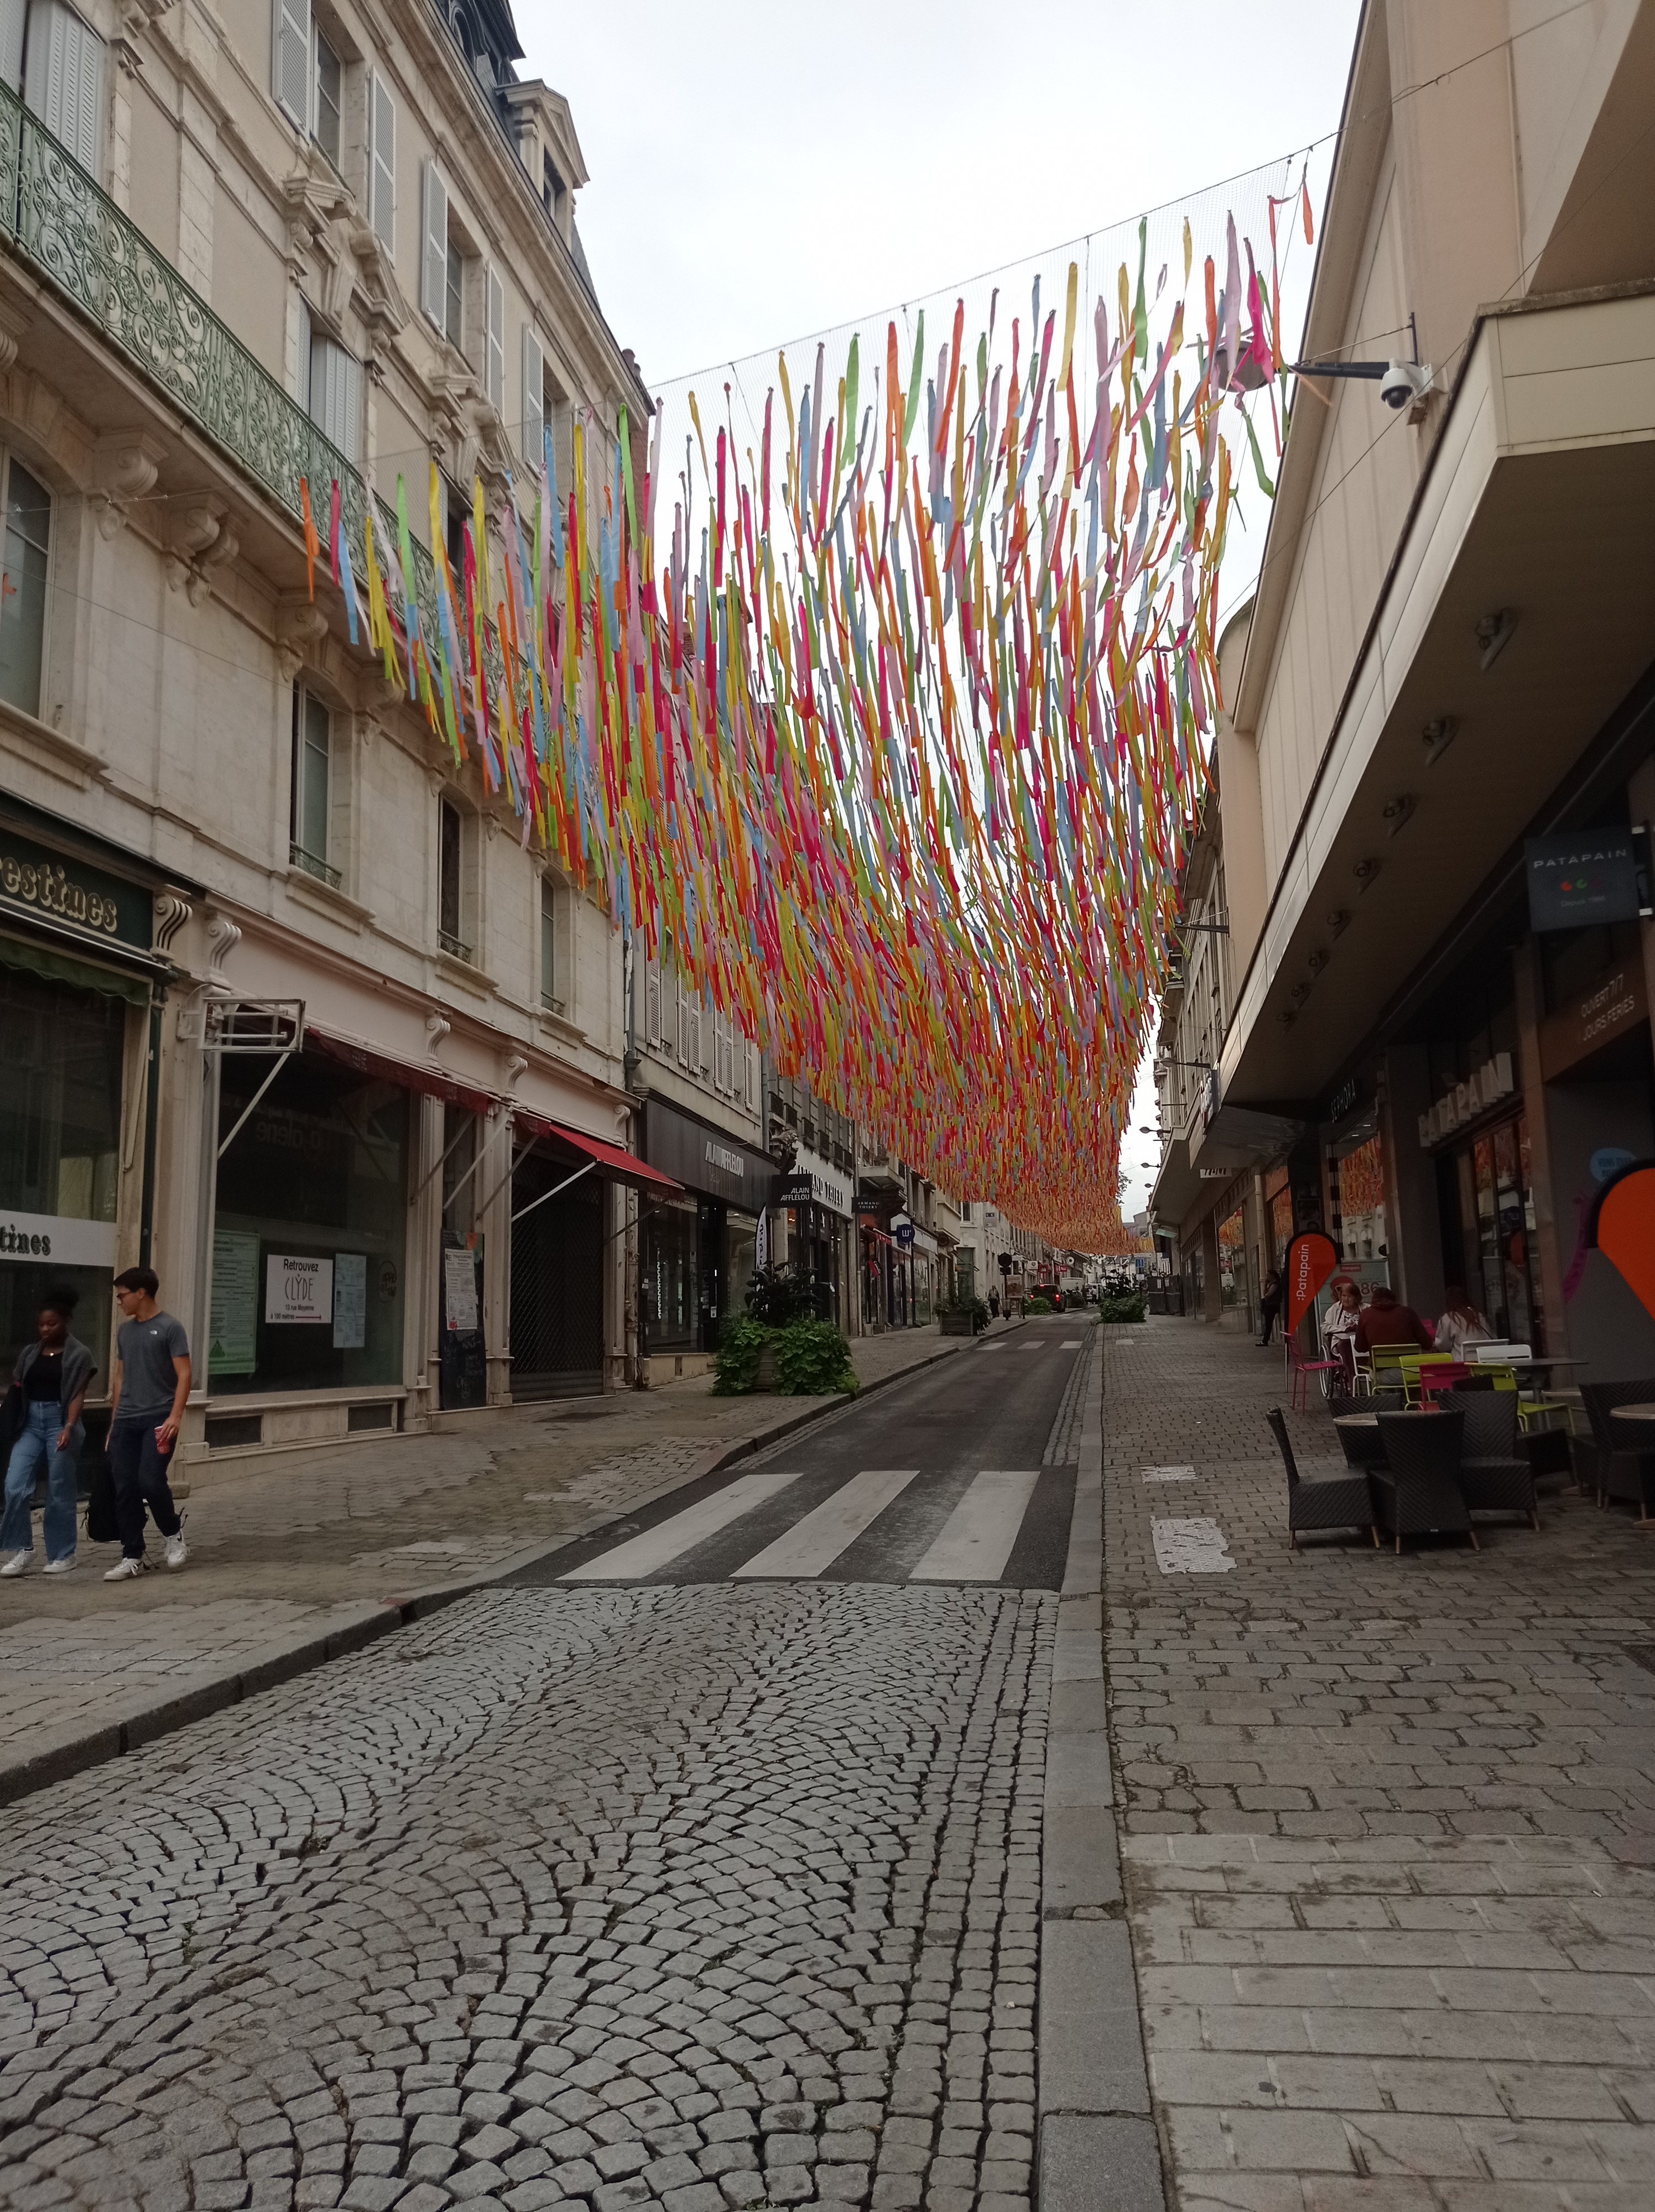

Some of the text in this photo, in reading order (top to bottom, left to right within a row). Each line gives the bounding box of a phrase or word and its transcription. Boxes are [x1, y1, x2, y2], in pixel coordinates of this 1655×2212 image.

[1533, 848, 1626, 869] PATAPAIN
[0, 857, 117, 932] estines
[1581, 973, 1623, 1017] OUVERT 7/7
[1583, 1014, 1606, 1041] JOURS
[1331, 1078, 1356, 1123] SEPHORA
[1418, 1052, 1514, 1147] PATAPAIN
[283, 1259, 319, 1272] Retrouvez
